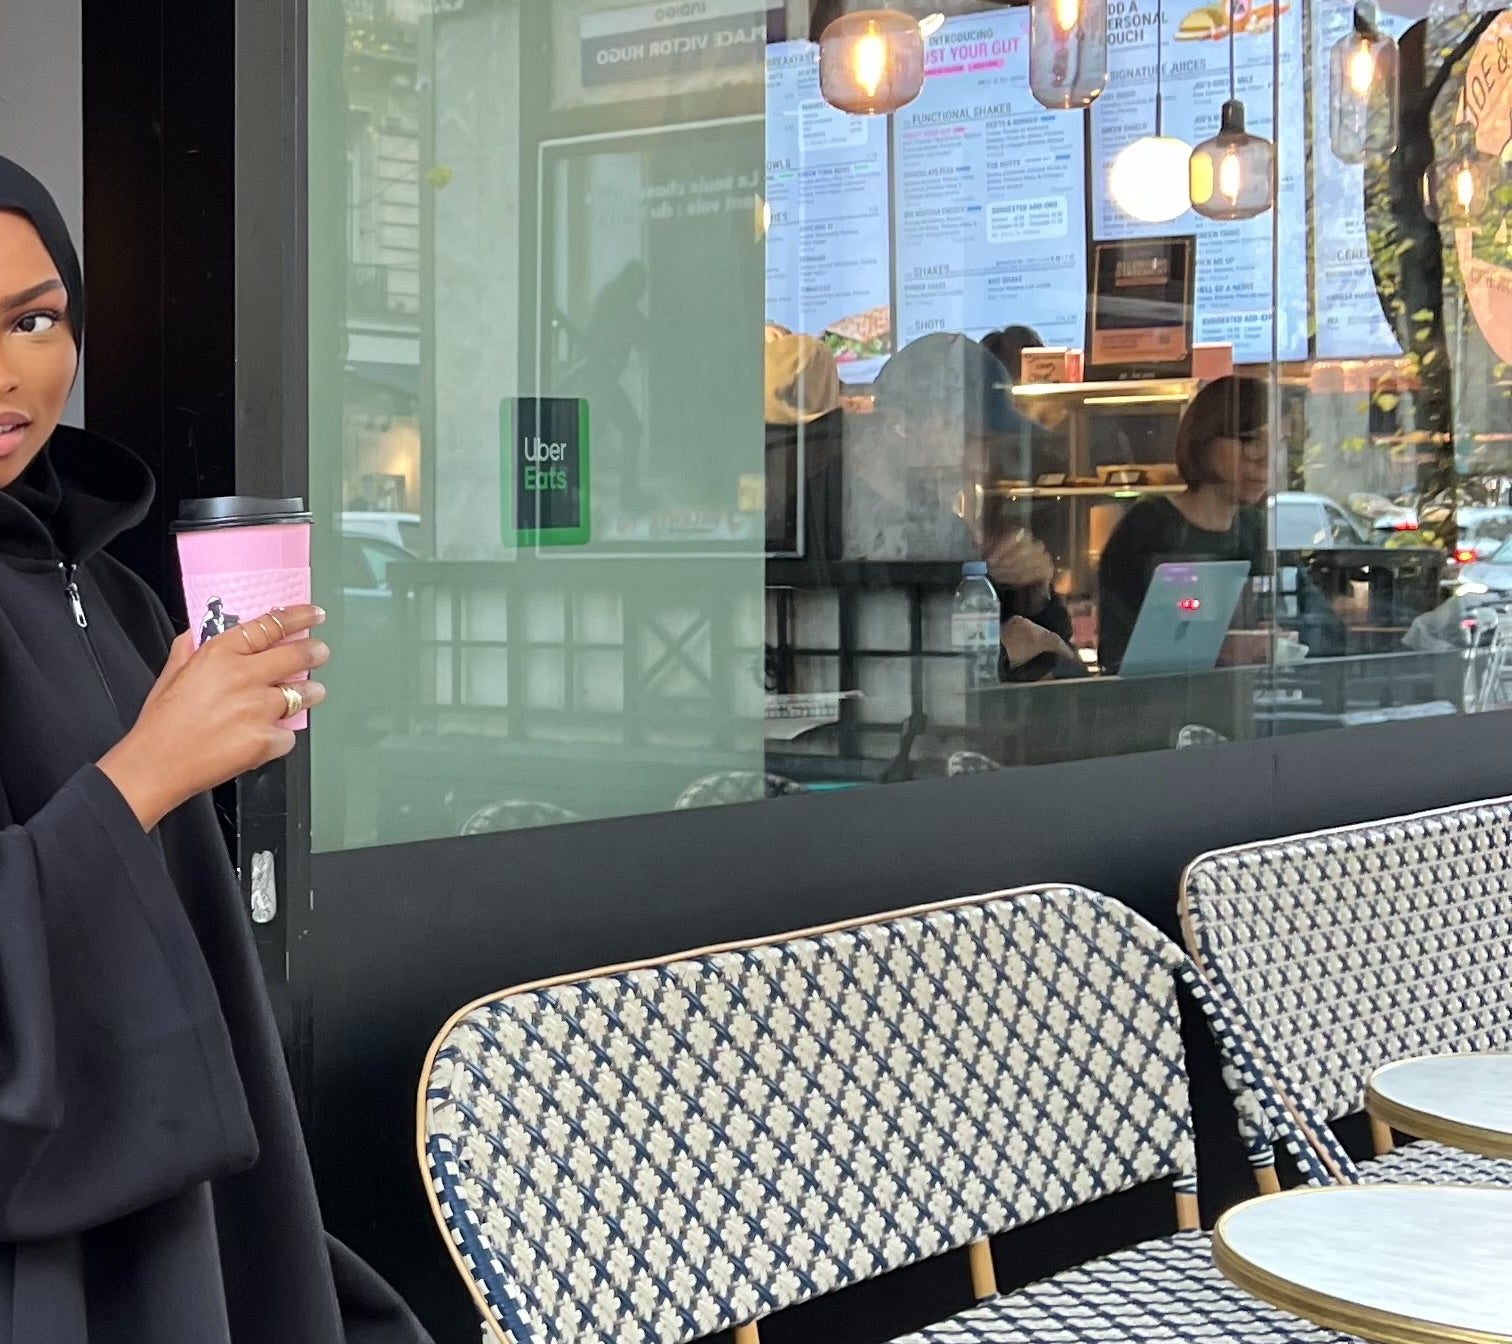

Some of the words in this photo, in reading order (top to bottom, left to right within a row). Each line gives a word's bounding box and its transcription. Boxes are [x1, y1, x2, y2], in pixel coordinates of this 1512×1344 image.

[1108, 1, 1125, 15] DD
[1108, 11, 1169, 30] ERSONAL
[1108, 29, 1144, 45] OUCH
[950, 41, 988, 61] YOUR
[992, 37, 1020, 55] GUT
[912, 108, 971, 125] FUNCTIONAL
[974, 102, 1012, 118] SHAKES
[524, 436, 567, 462] Uber
[524, 466, 568, 491] Eats
